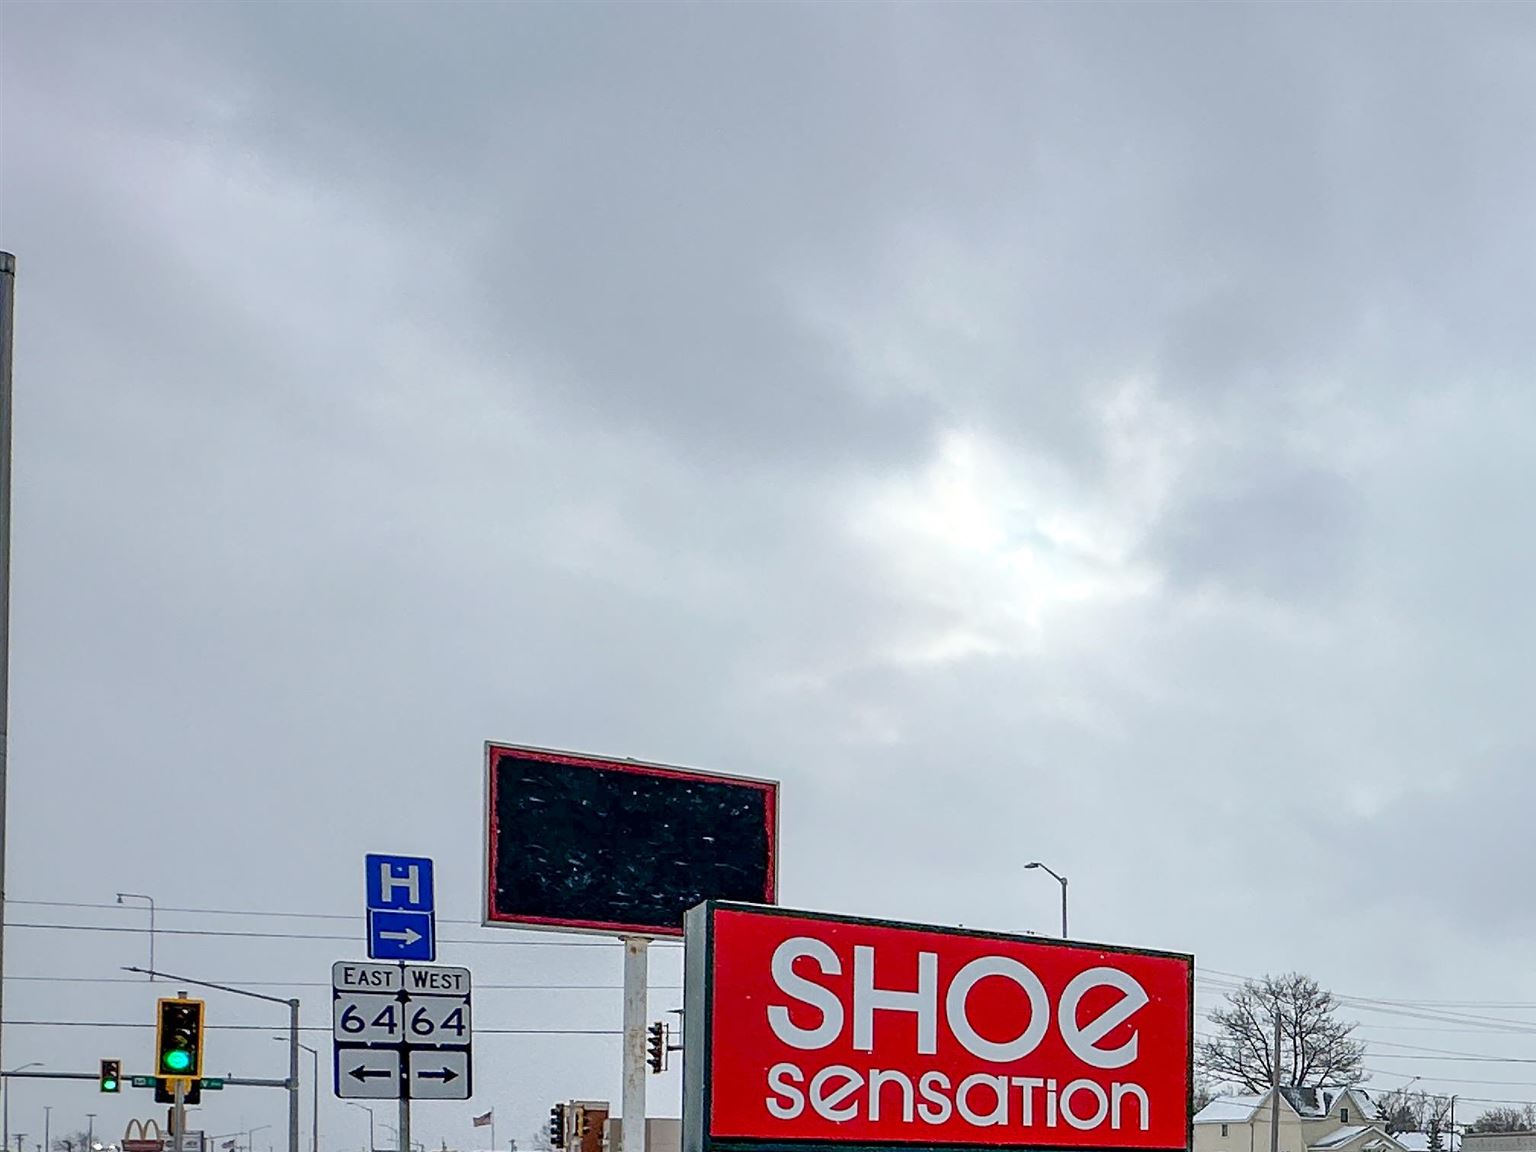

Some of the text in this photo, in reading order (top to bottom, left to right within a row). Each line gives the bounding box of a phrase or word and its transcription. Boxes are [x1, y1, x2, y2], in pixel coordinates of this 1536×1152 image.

[380, 863, 419, 904] H
[344, 967, 393, 987] EAST
[412, 970, 463, 990] WEST
[340, 1004, 398, 1035] 64
[411, 1006, 466, 1037] 64
